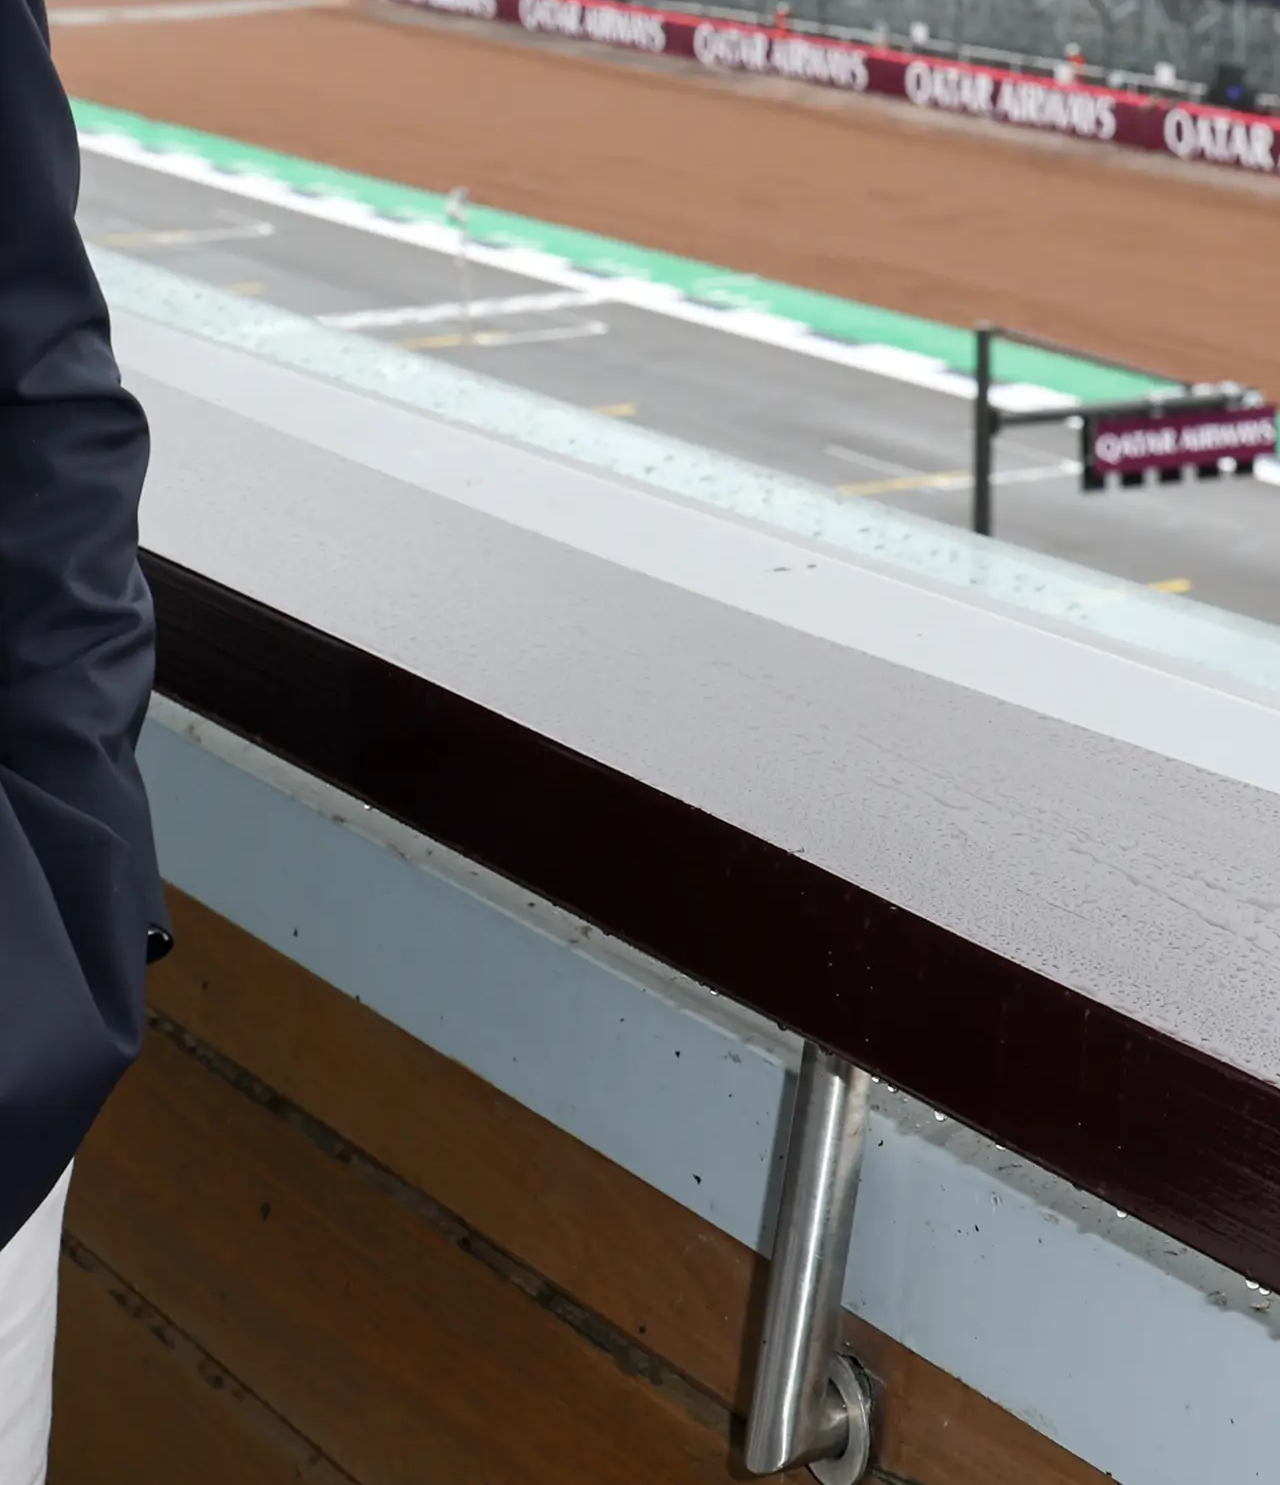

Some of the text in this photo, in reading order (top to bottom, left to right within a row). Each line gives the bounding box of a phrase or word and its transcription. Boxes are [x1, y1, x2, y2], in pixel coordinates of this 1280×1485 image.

[693, 22, 868, 92] QATAR AIRWAYS
[905, 60, 1117, 140] QATAR AIRWAYS
[1163, 107, 1275, 171] QATAR
[1095, 427, 1176, 463] QATAR
